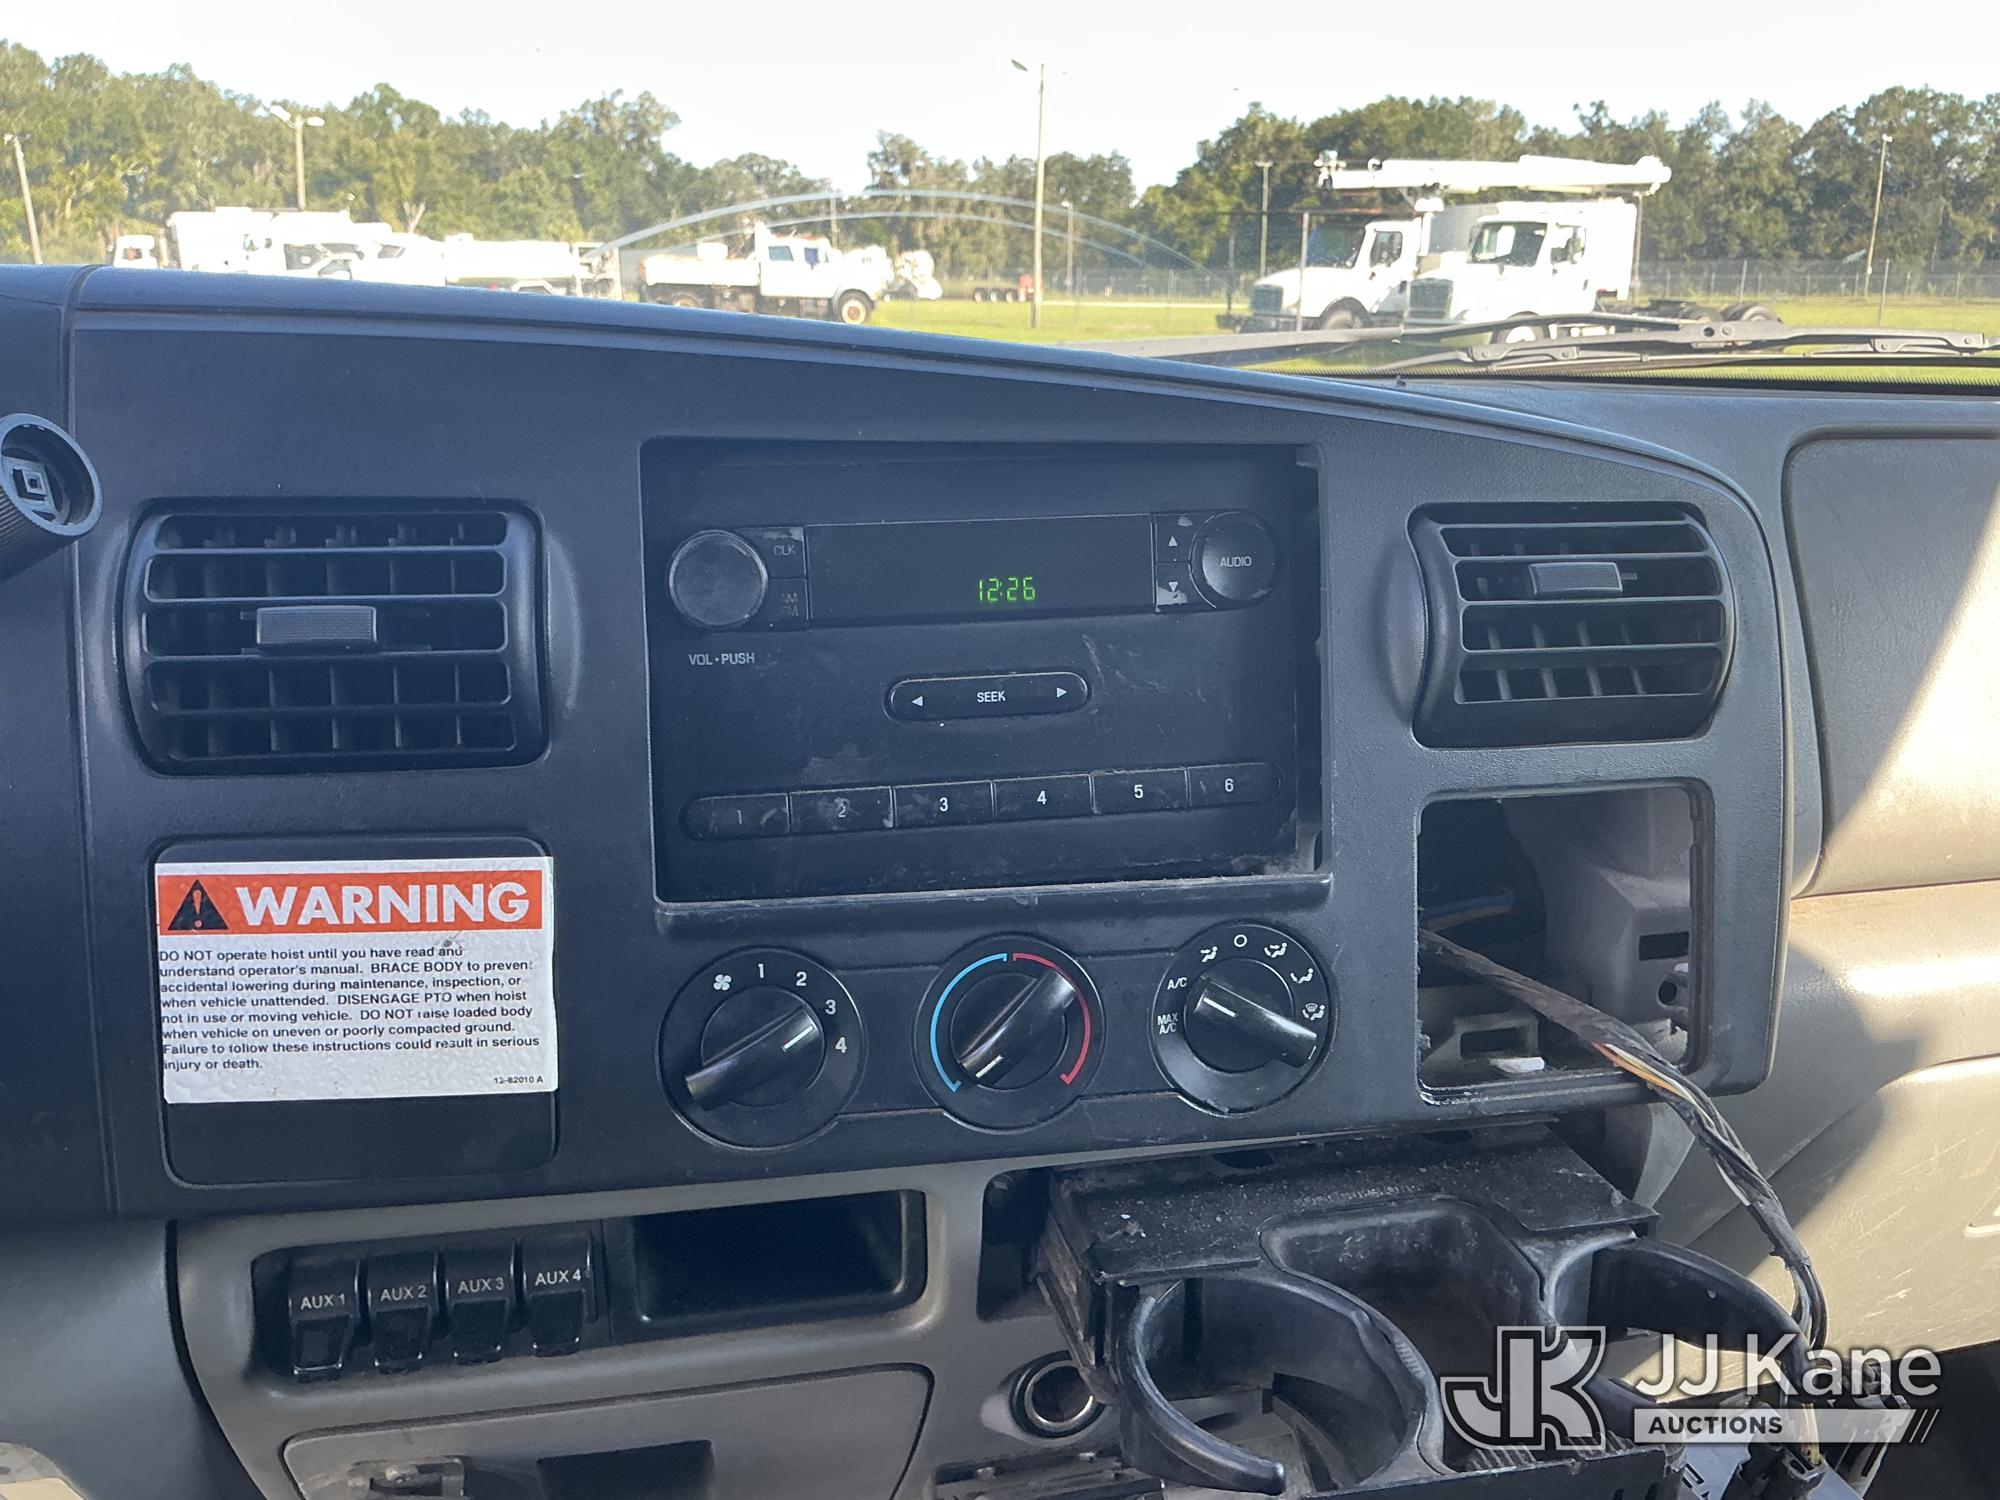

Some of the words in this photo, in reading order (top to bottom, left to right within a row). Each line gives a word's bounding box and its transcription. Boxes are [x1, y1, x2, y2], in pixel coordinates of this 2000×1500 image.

[773, 544, 796, 556] CLK
[1220, 556, 1252, 568] AUDIO
[978, 576, 1036, 601] 12:26
[976, 690, 1006, 703] SEEK
[1134, 784, 1144, 799] 5
[1224, 778, 1234, 793] 6
[939, 796, 949, 812] 3
[1037, 790, 1047, 805] 4
[736, 809, 743, 825] 1
[838, 804, 848, 818] 2
[235, 881, 529, 926] WARNING
[159, 950, 179, 962] DO
[184, 950, 212, 962] NOT
[217, 950, 267, 966] operate
[271, 948, 305, 960] hoist
[308, 947, 338, 959] until
[342, 950, 366, 961] you
[370, 947, 401, 958] have
[405, 946, 435, 957] read
[438, 946, 463, 957] and
[160, 966, 235, 977] understand
[239, 964, 307, 977] operator's
[310, 963, 364, 975] manual.
[371, 962, 420, 974] BRACE
[423, 961, 463, 973] BODY
[467, 961, 480, 971] to
[758, 963, 765, 979] 1
[160, 981, 228, 993] accidental
[232, 980, 289, 993] lowering
[293, 979, 336, 993] during
[340, 978, 429, 990] maintenance,
[432, 976, 505, 989] inspection,
[508, 977, 522, 987] or
[796, 971, 808, 987] 2
[1167, 977, 1188, 990] A/C
[162, 996, 197, 1008] when
[200, 996, 247, 1007] vehicle
[251, 994, 329, 1007] unattended.
[337, 993, 421, 1005] DISENGAGE
[424, 992, 453, 1004] PTO
[456, 991, 491, 1002] when
[494, 991, 528, 1002] hoist
[825, 999, 837, 1015] 3
[162, 1013, 184, 1024] not
[187, 1012, 199, 1024] in
[203, 1013, 227, 1023] use
[230, 1013, 244, 1023] or
[248, 1011, 298, 1024] moving
[301, 1010, 353, 1021] vehicle.
[360, 1009, 381, 1021] DO
[384, 1008, 414, 1020] NOT
[417, 1008, 450, 1019] raise
[453, 1006, 497, 1018] loaded
[500, 1006, 533, 1019] body
[1157, 1012, 1179, 1026] MAX
[163, 1027, 198, 1039] when
[201, 1026, 249, 1039] vehicle
[252, 1028, 269, 1038] on
[272, 1027, 321, 1038] uneven
[324, 1027, 339, 1037] or
[342, 1024, 385, 1038] poorly
[388, 1022, 461, 1036] compacted
[464, 1021, 516, 1035] ground.
[1159, 1022, 1177, 1035] A/C
[164, 1043, 208, 1055] Failure
[212, 1043, 226, 1055] to
[229, 1042, 269, 1054] follow
[272, 1041, 309, 1053] these
[312, 1040, 391, 1052] instructions
[395, 1038, 432, 1050] could
[435, 1038, 474, 1049] result
[477, 1037, 488, 1048] in
[491, 1036, 541, 1048] serious
[835, 1036, 848, 1053] 4
[164, 1060, 201, 1072] injury
[204, 1060, 219, 1070] or
[222, 1058, 264, 1069] death.
[537, 1076, 544, 1084] A
[458, 1279, 491, 1294] AUX
[495, 1277, 505, 1291] 3
[535, 1271, 569, 1286] AUX
[572, 1269, 582, 1282] 4
[380, 1288, 412, 1302] AUX
[417, 1285, 427, 1299] 2
[300, 1295, 335, 1311] AUX
[339, 1293, 346, 1306] 1
